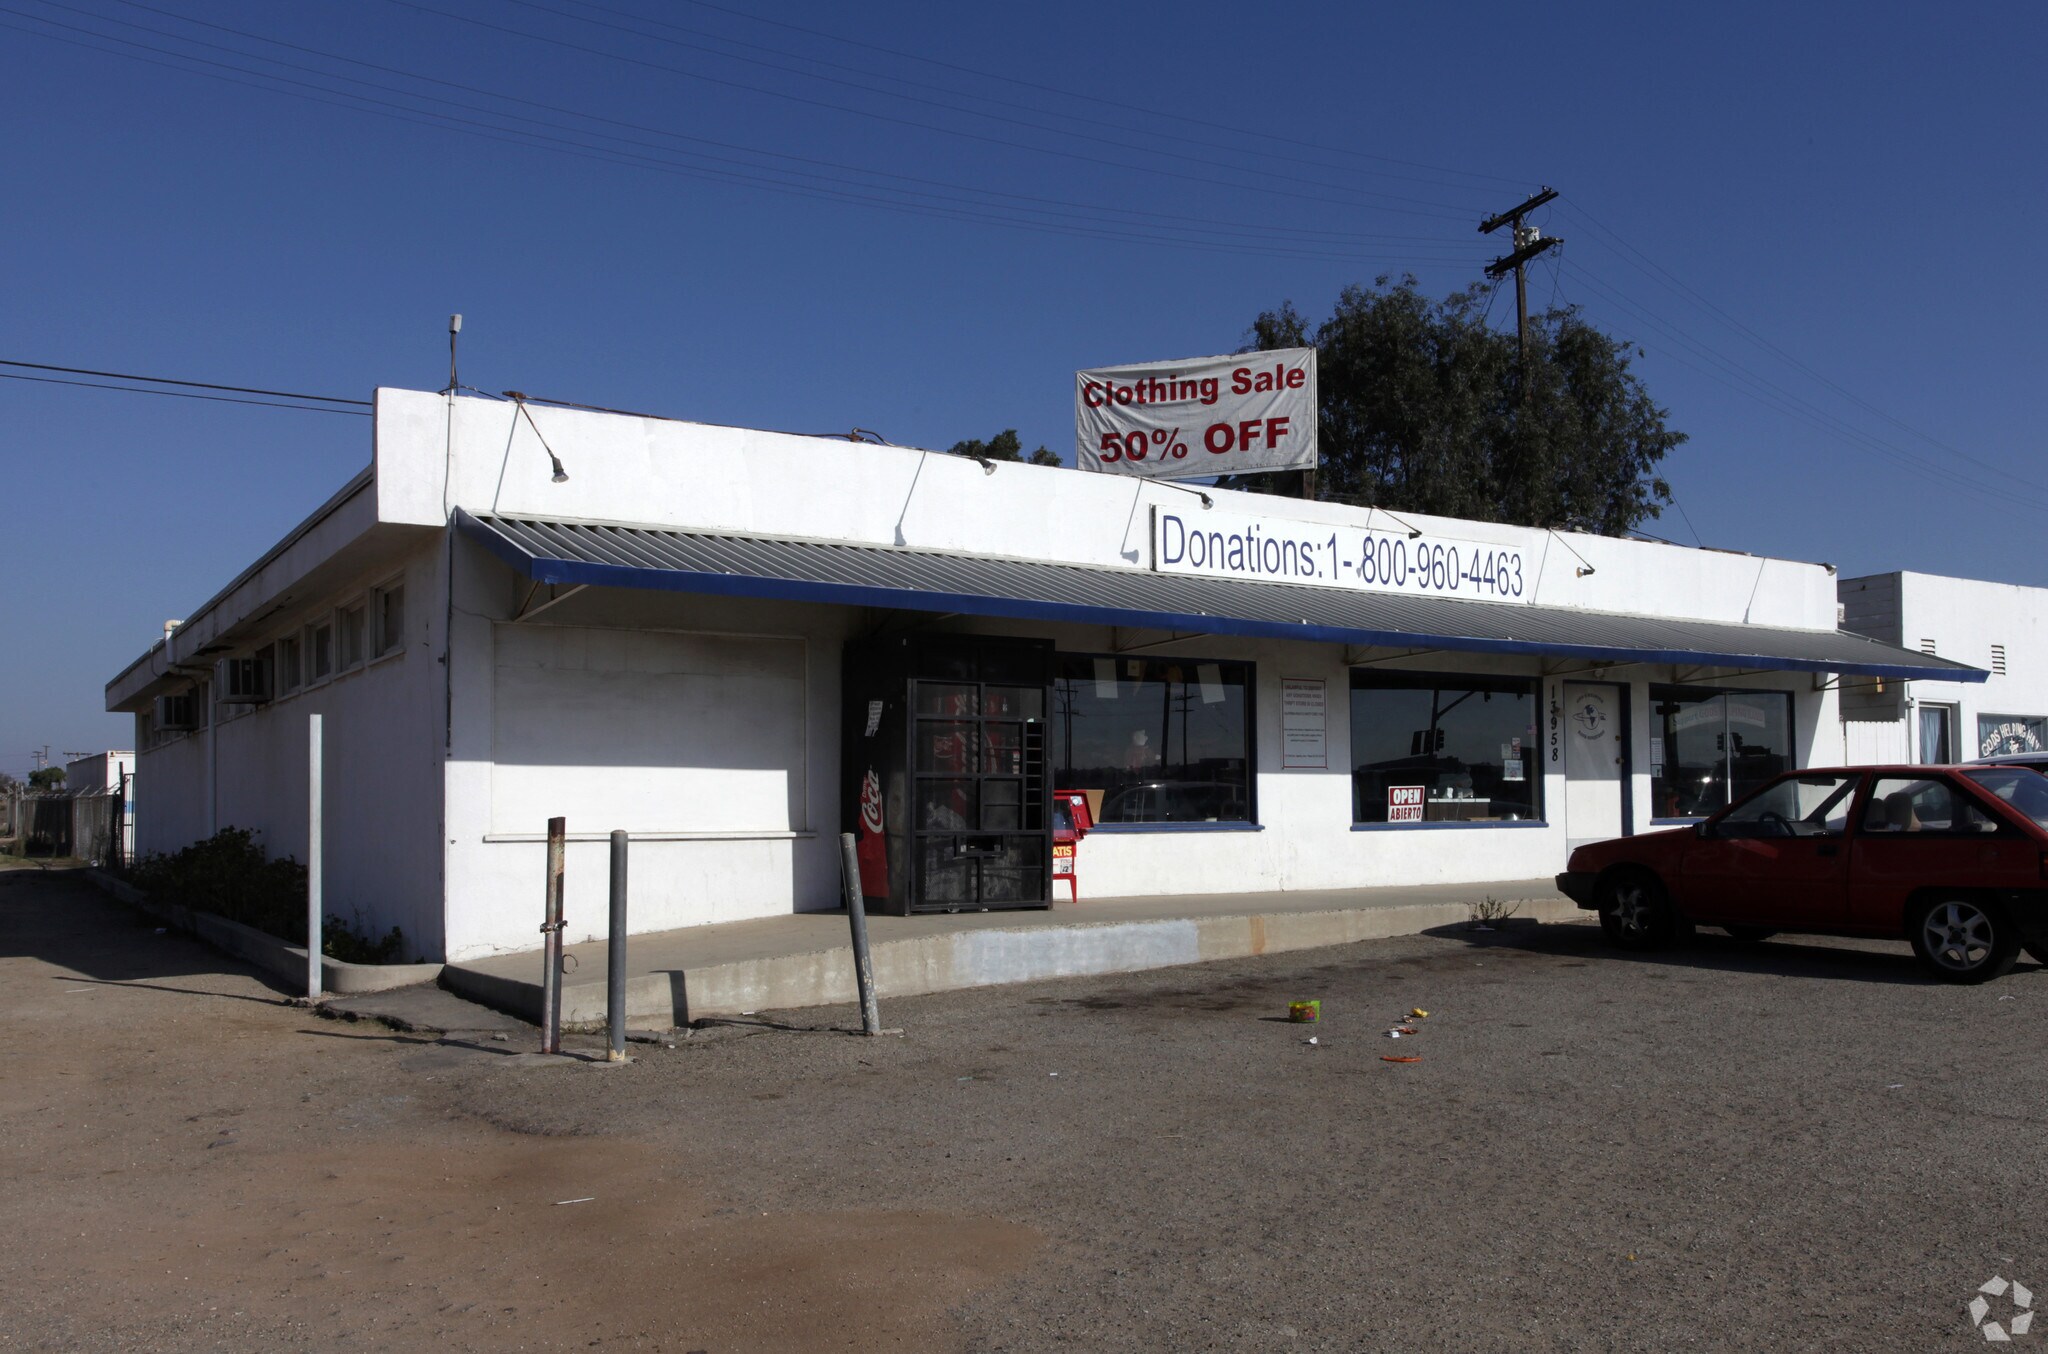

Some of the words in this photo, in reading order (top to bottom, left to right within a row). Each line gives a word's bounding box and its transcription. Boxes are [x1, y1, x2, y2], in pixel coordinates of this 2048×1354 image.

[1083, 374, 1219, 408] Clothing
[1231, 363, 1305, 395] Sale
[1099, 427, 1188, 463] 50%
[1204, 416, 1290, 454] OFF
[1550, 685, 1559, 762] 13958
[1981, 729, 2001, 757] GODS
[1999, 722, 2027, 739] HELPING
[1390, 806, 1422, 821] ABIERTO
[1392, 788, 1422, 805] OPEN
[1052, 845, 1073, 857] ATIS
